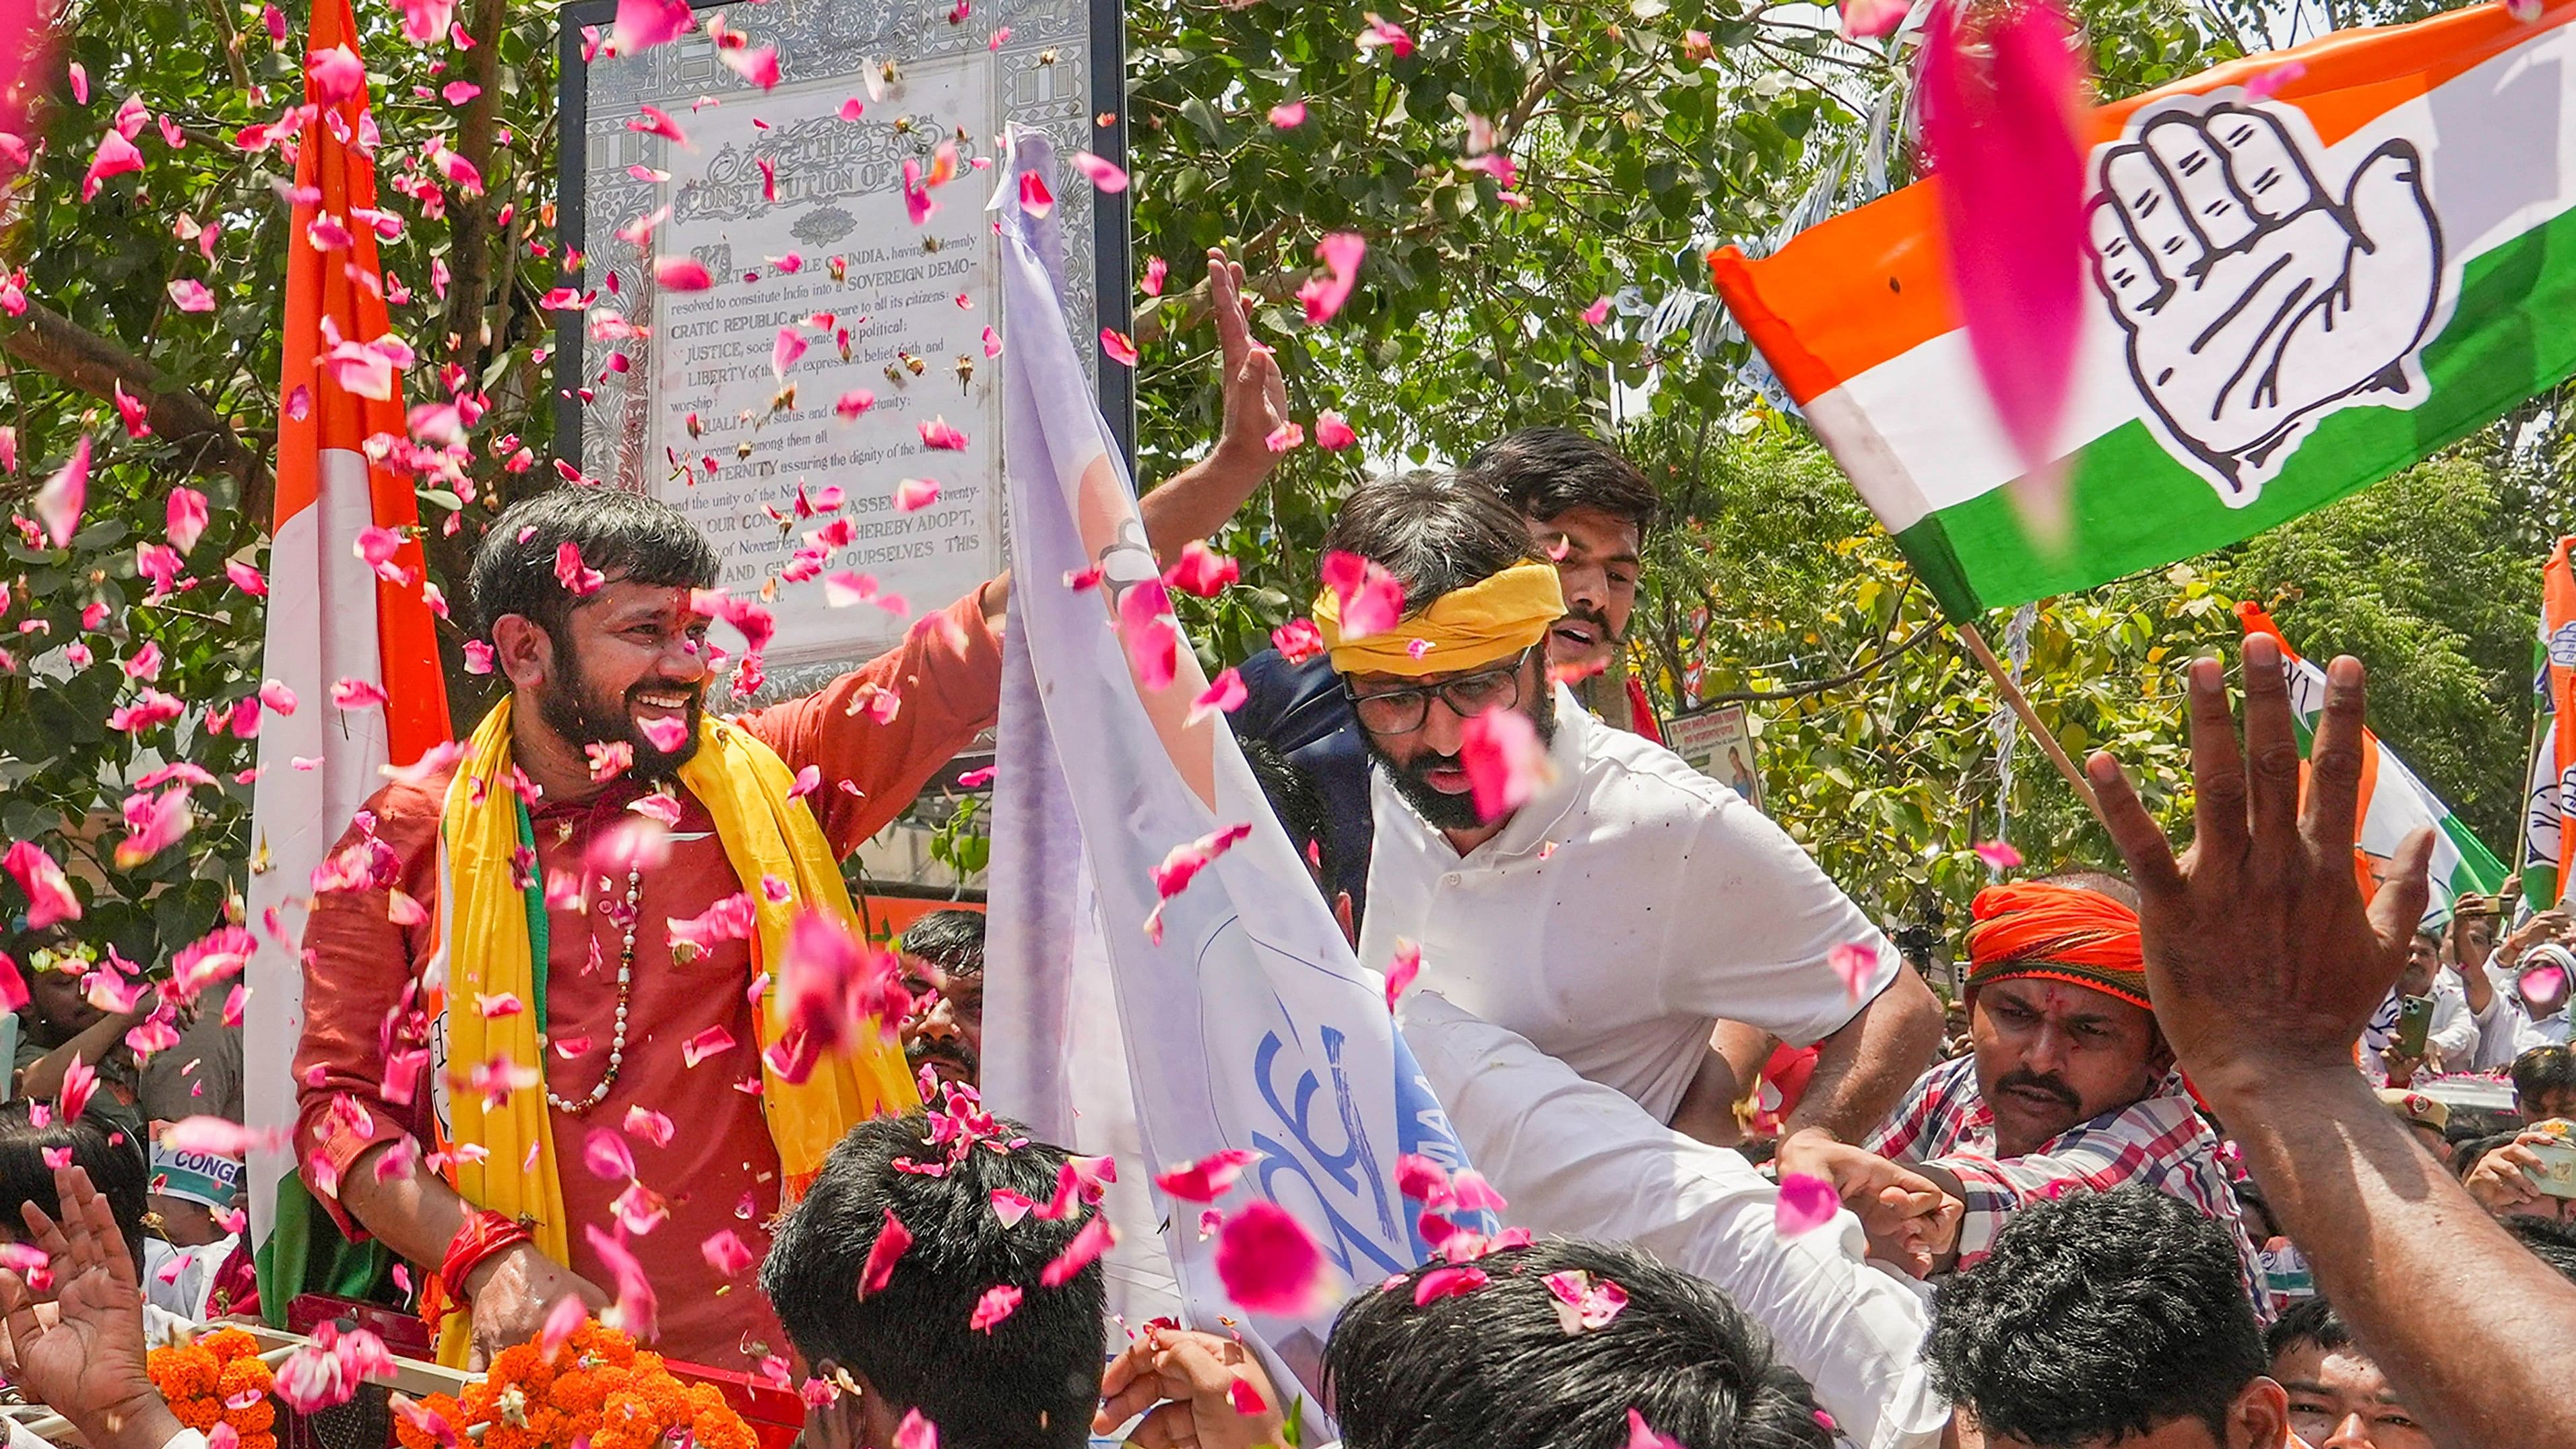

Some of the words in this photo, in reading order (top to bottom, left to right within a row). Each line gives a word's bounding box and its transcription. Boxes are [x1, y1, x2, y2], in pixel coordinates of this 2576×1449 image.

[800, 133, 847, 160] THE
[686, 168, 854, 213] CONSTUTION
[860, 162, 893, 187] OF
[767, 258, 821, 278] PELE
[848, 248, 891, 267] INDIA,
[937, 233, 977, 252] lemnly
[671, 296, 714, 316] resolved
[716, 298, 726, 310] to
[729, 290, 781, 308] constitute
[783, 286, 809, 300] India
[812, 283, 832, 296] into
[847, 267, 924, 291] SOVEREIGN
[928, 258, 977, 279] DEMO-
[671, 319, 719, 340] CRATIC
[724, 311, 787, 333] REPUBLIC
[862, 302, 871, 313] to
[874, 296, 887, 311] all
[890, 294, 903, 309] its
[684, 342, 744, 366] JUSTICE,
[688, 364, 747, 387] LIBERTY
[748, 364, 761, 379] of
[926, 337, 944, 352] and
[808, 404, 828, 420] and
[781, 455, 828, 473] assuring
[830, 451, 847, 467] the
[849, 443, 884, 465] dignity
[887, 445, 899, 459] of
[901, 441, 915, 457] the
[787, 432, 811, 447] them
[815, 430, 829, 444] all
[693, 495, 709, 510] the
[713, 491, 741, 511] unity
[744, 488, 758, 503] of
[759, 488, 775, 503] the
[707, 515, 736, 534] OUR
[944, 486, 980, 503] twenty-
[722, 542, 736, 557] of
[856, 517, 913, 541] HEREBY
[917, 509, 975, 532] ADOPT,
[725, 563, 756, 583] AND
[846, 540, 934, 567] OURSELVES
[945, 535, 980, 553] THIS
[174, 1150, 237, 1184] CONG
